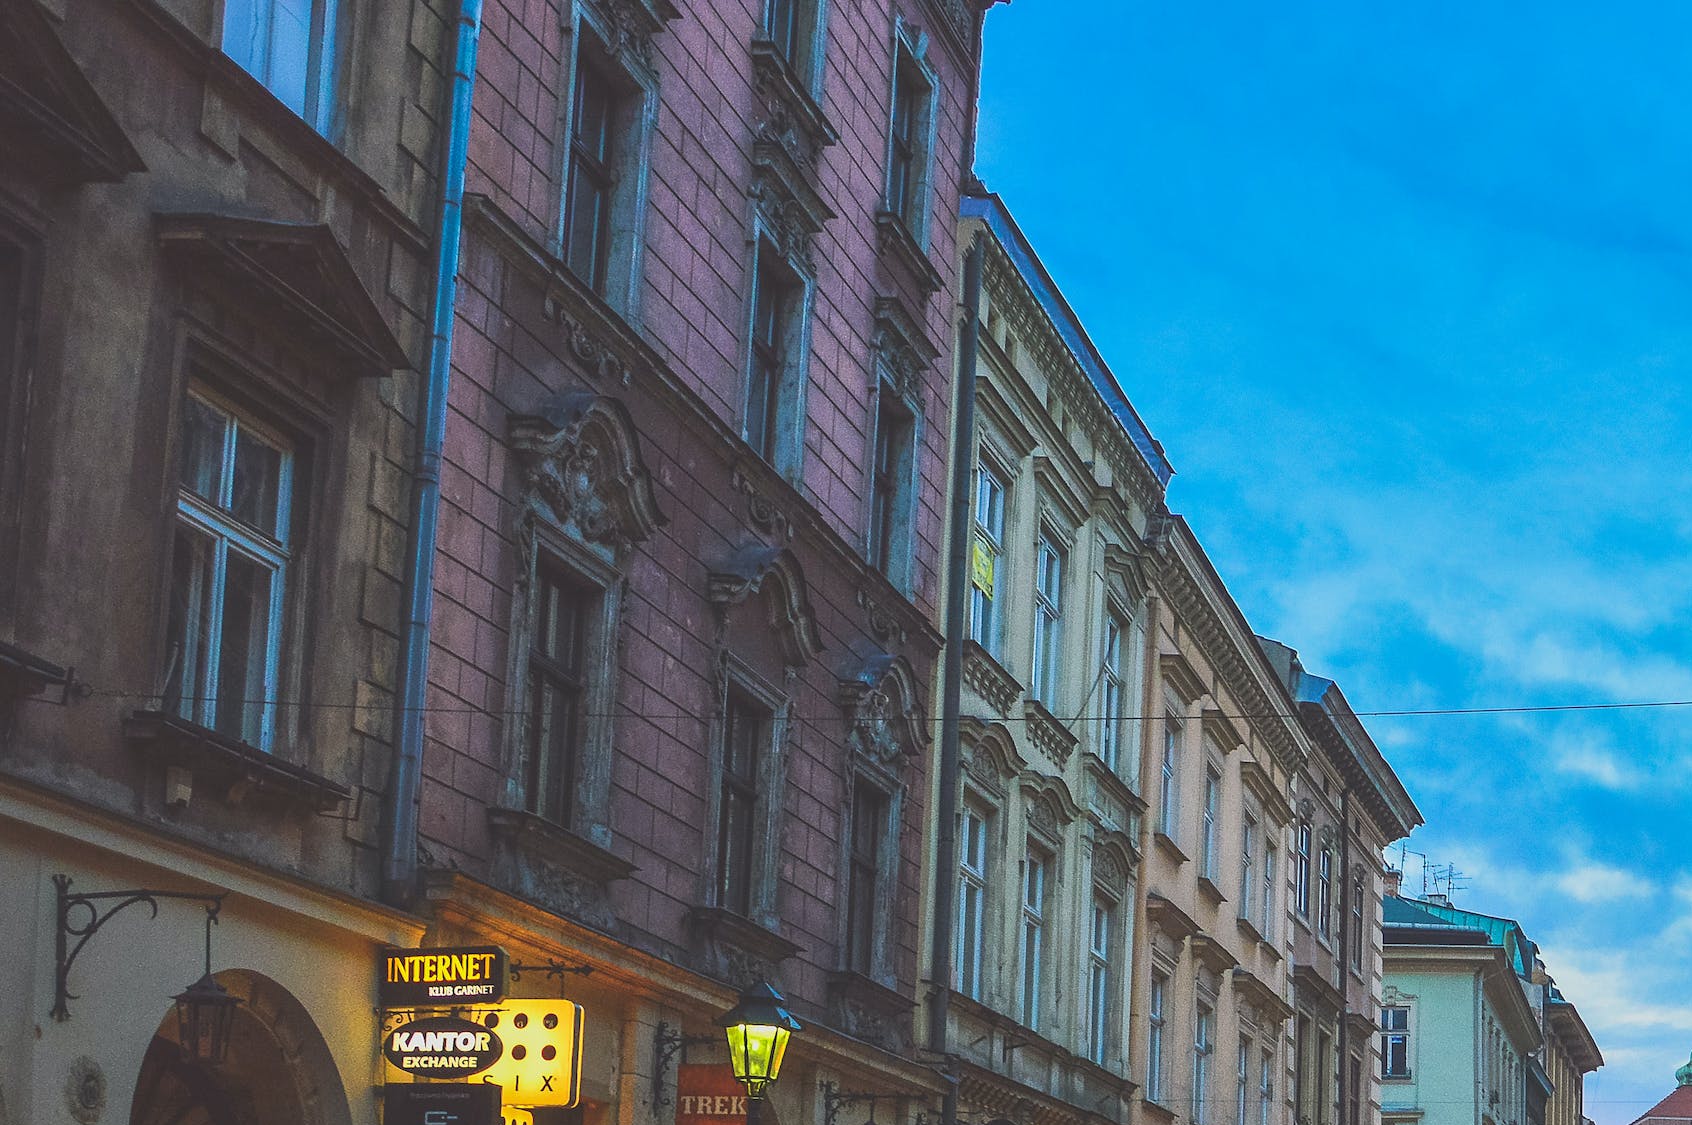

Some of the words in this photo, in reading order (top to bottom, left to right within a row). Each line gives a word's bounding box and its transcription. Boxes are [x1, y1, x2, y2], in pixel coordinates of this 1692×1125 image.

[387, 953, 496, 983] INTERNET
[429, 986, 454, 997] KLUB
[392, 1032, 491, 1052] KANTOR
[402, 1056, 478, 1069] EXCHANGE
[680, 1095, 747, 1116] TREK
